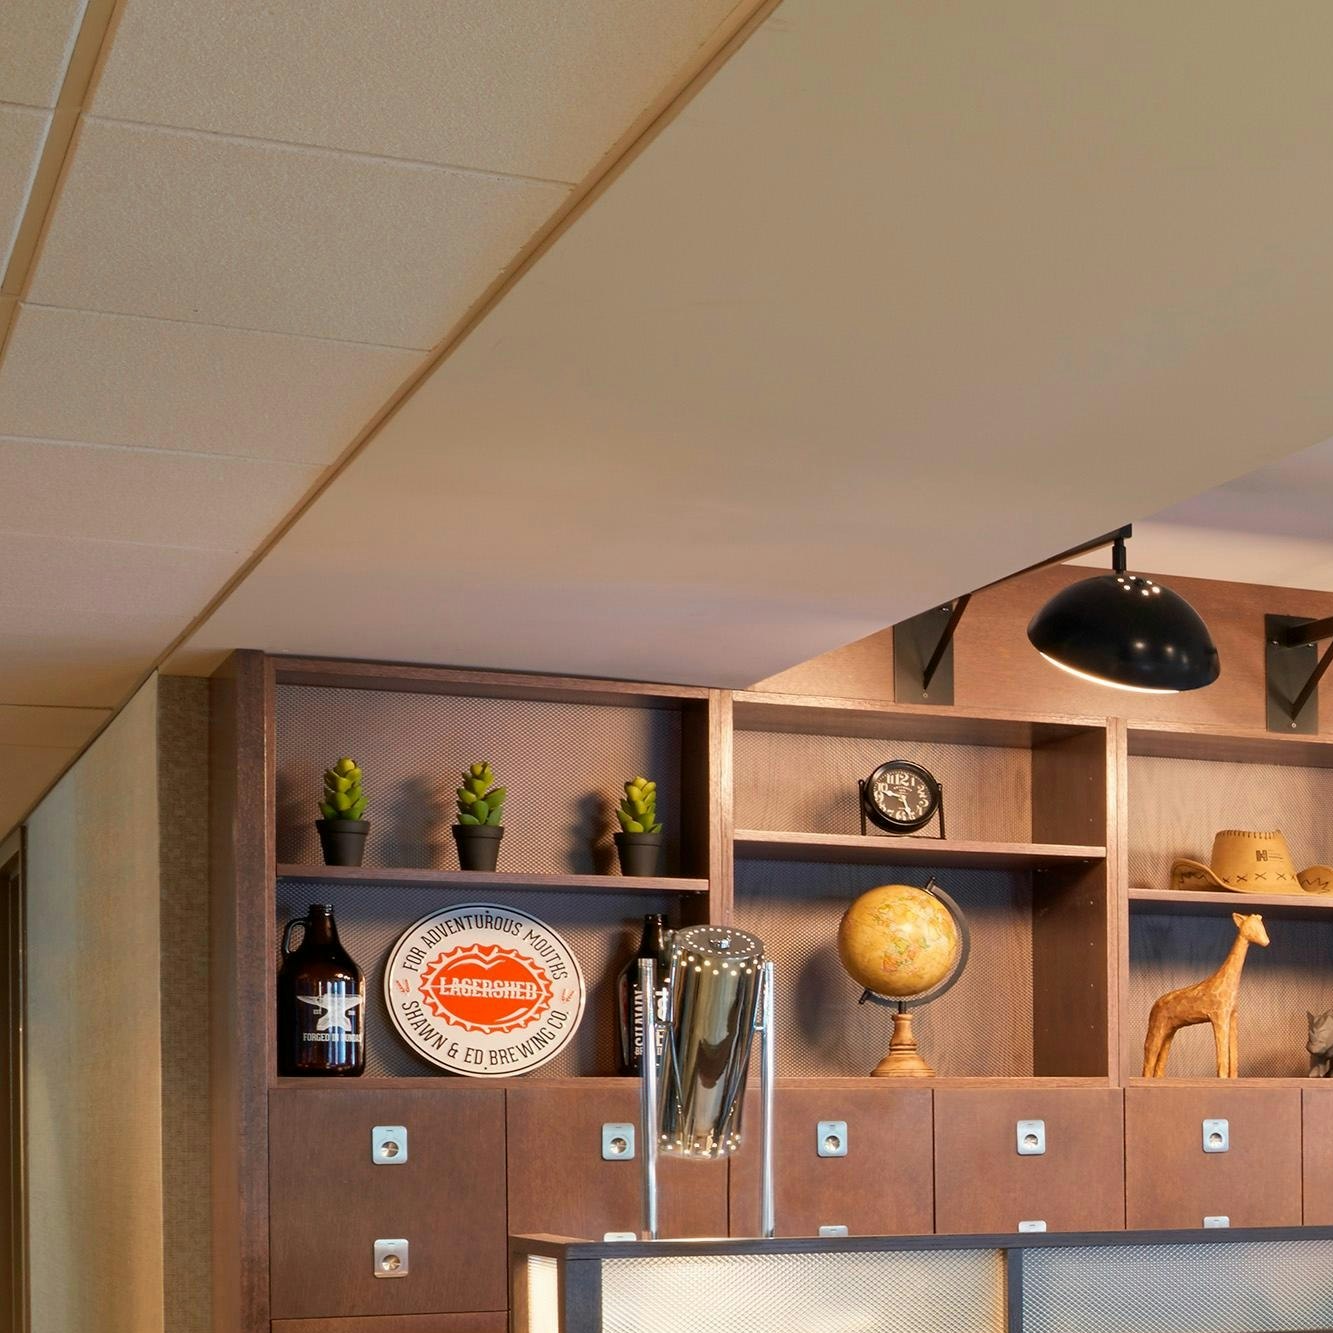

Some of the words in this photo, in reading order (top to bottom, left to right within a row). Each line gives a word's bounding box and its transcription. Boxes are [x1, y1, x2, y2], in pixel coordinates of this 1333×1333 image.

[403, 946, 427, 972] FOR
[421, 914, 523, 949] ADVENTUROUS
[523, 929, 568, 981] MOUTHS
[439, 976, 538, 1000] LAGERSHED
[402, 1000, 448, 1051] SHAWN
[447, 1042, 459, 1059] &
[464, 1047, 484, 1065] ED
[489, 1027, 555, 1066] BREWING
[546, 1009, 570, 1030] CO.
